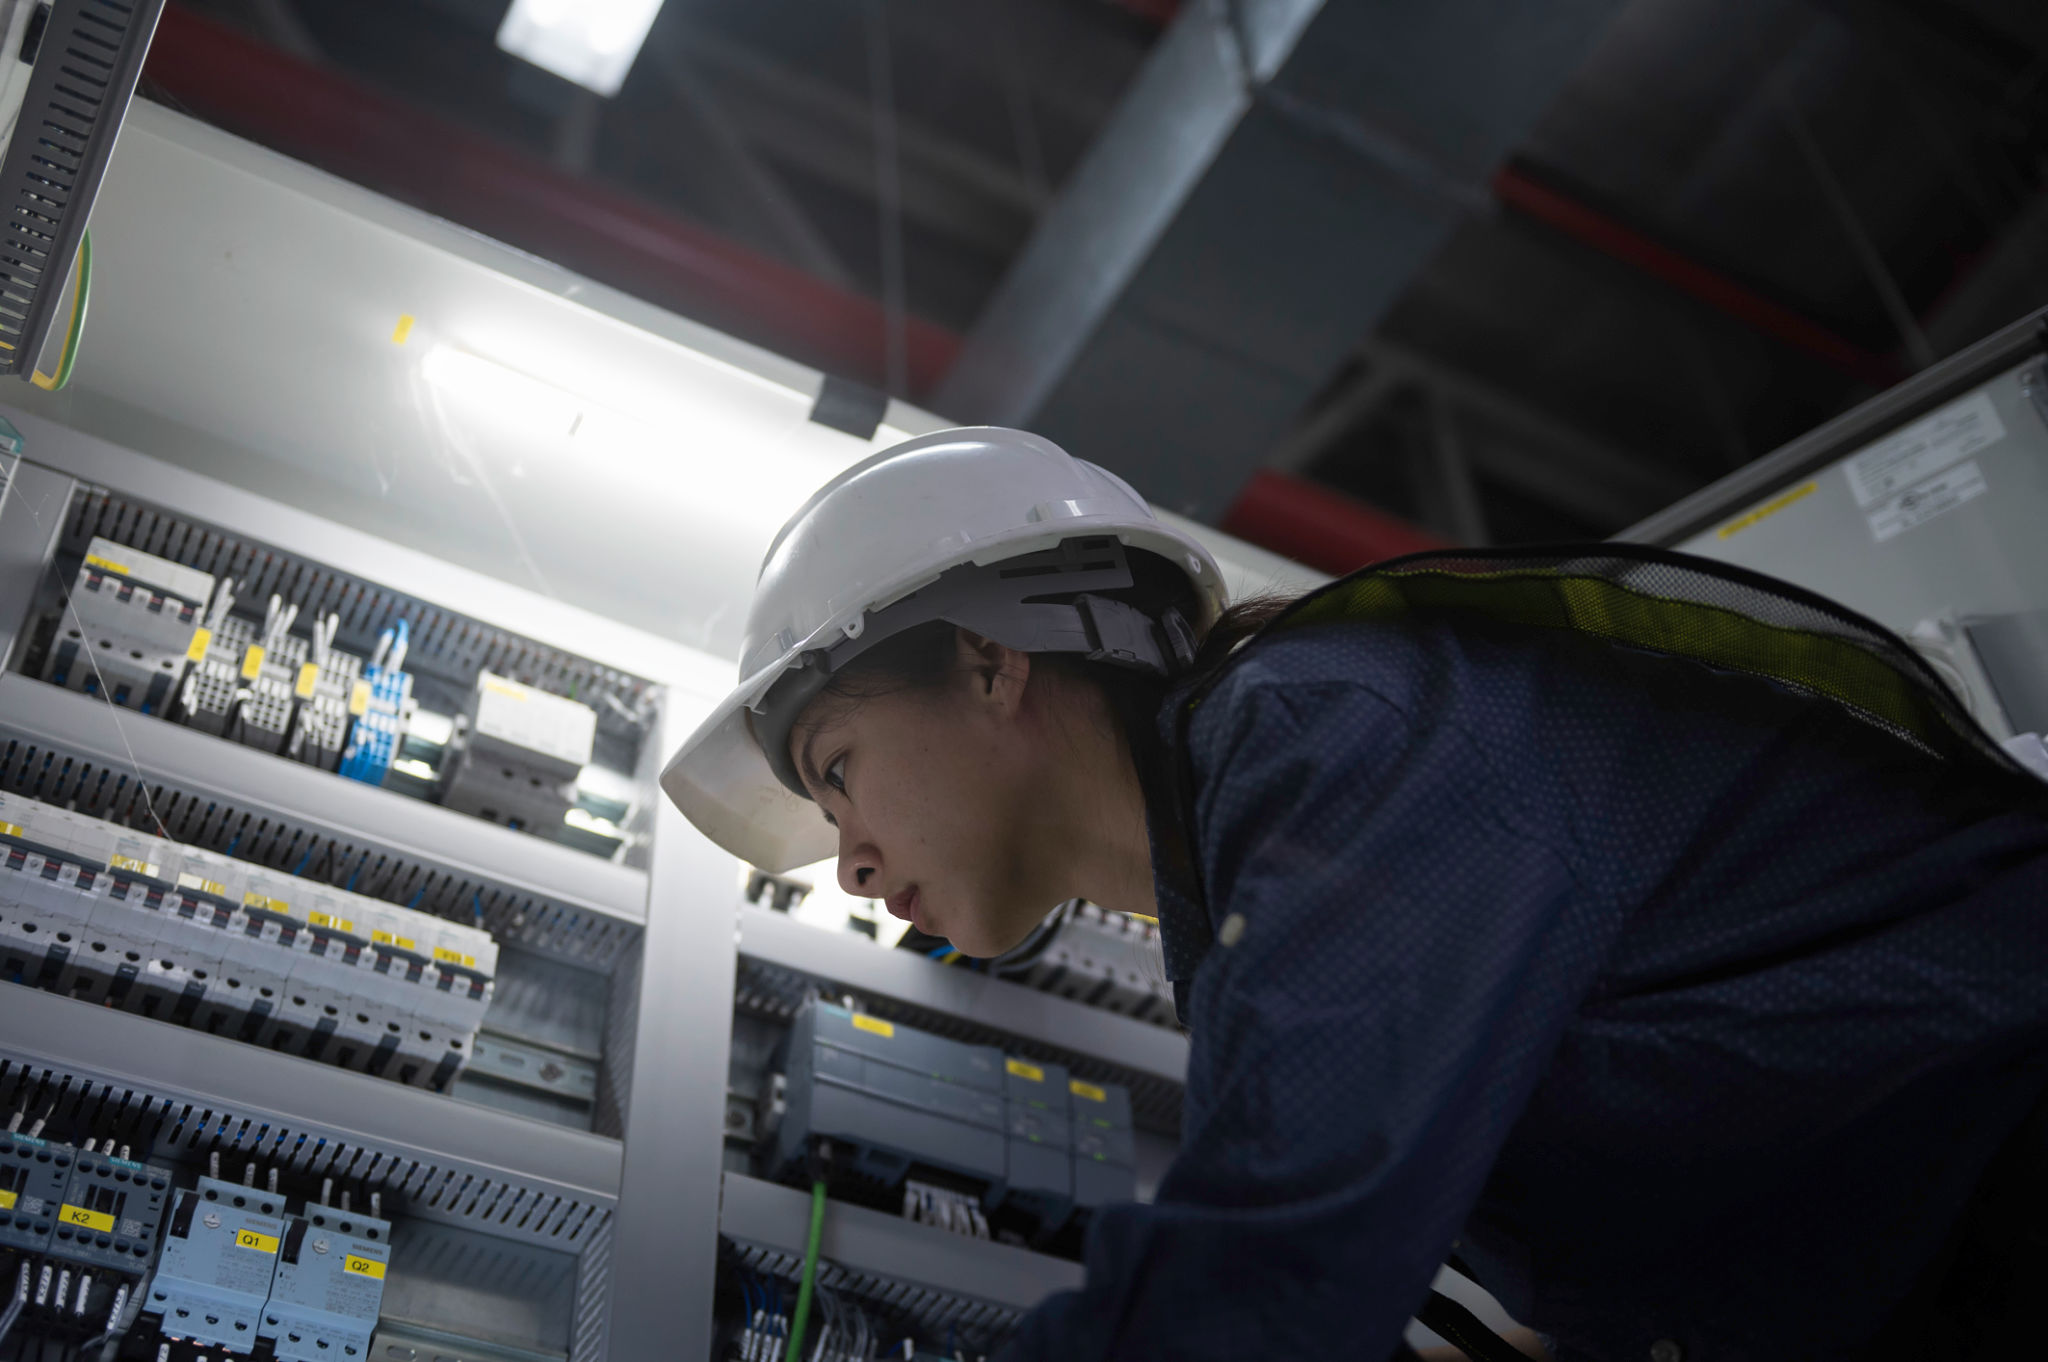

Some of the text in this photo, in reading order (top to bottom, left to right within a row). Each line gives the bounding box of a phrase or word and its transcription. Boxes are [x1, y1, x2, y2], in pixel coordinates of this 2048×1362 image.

[71, 1211, 90, 1225] K2
[242, 1234, 259, 1247] Q1
[352, 1260, 369, 1273] Q2
